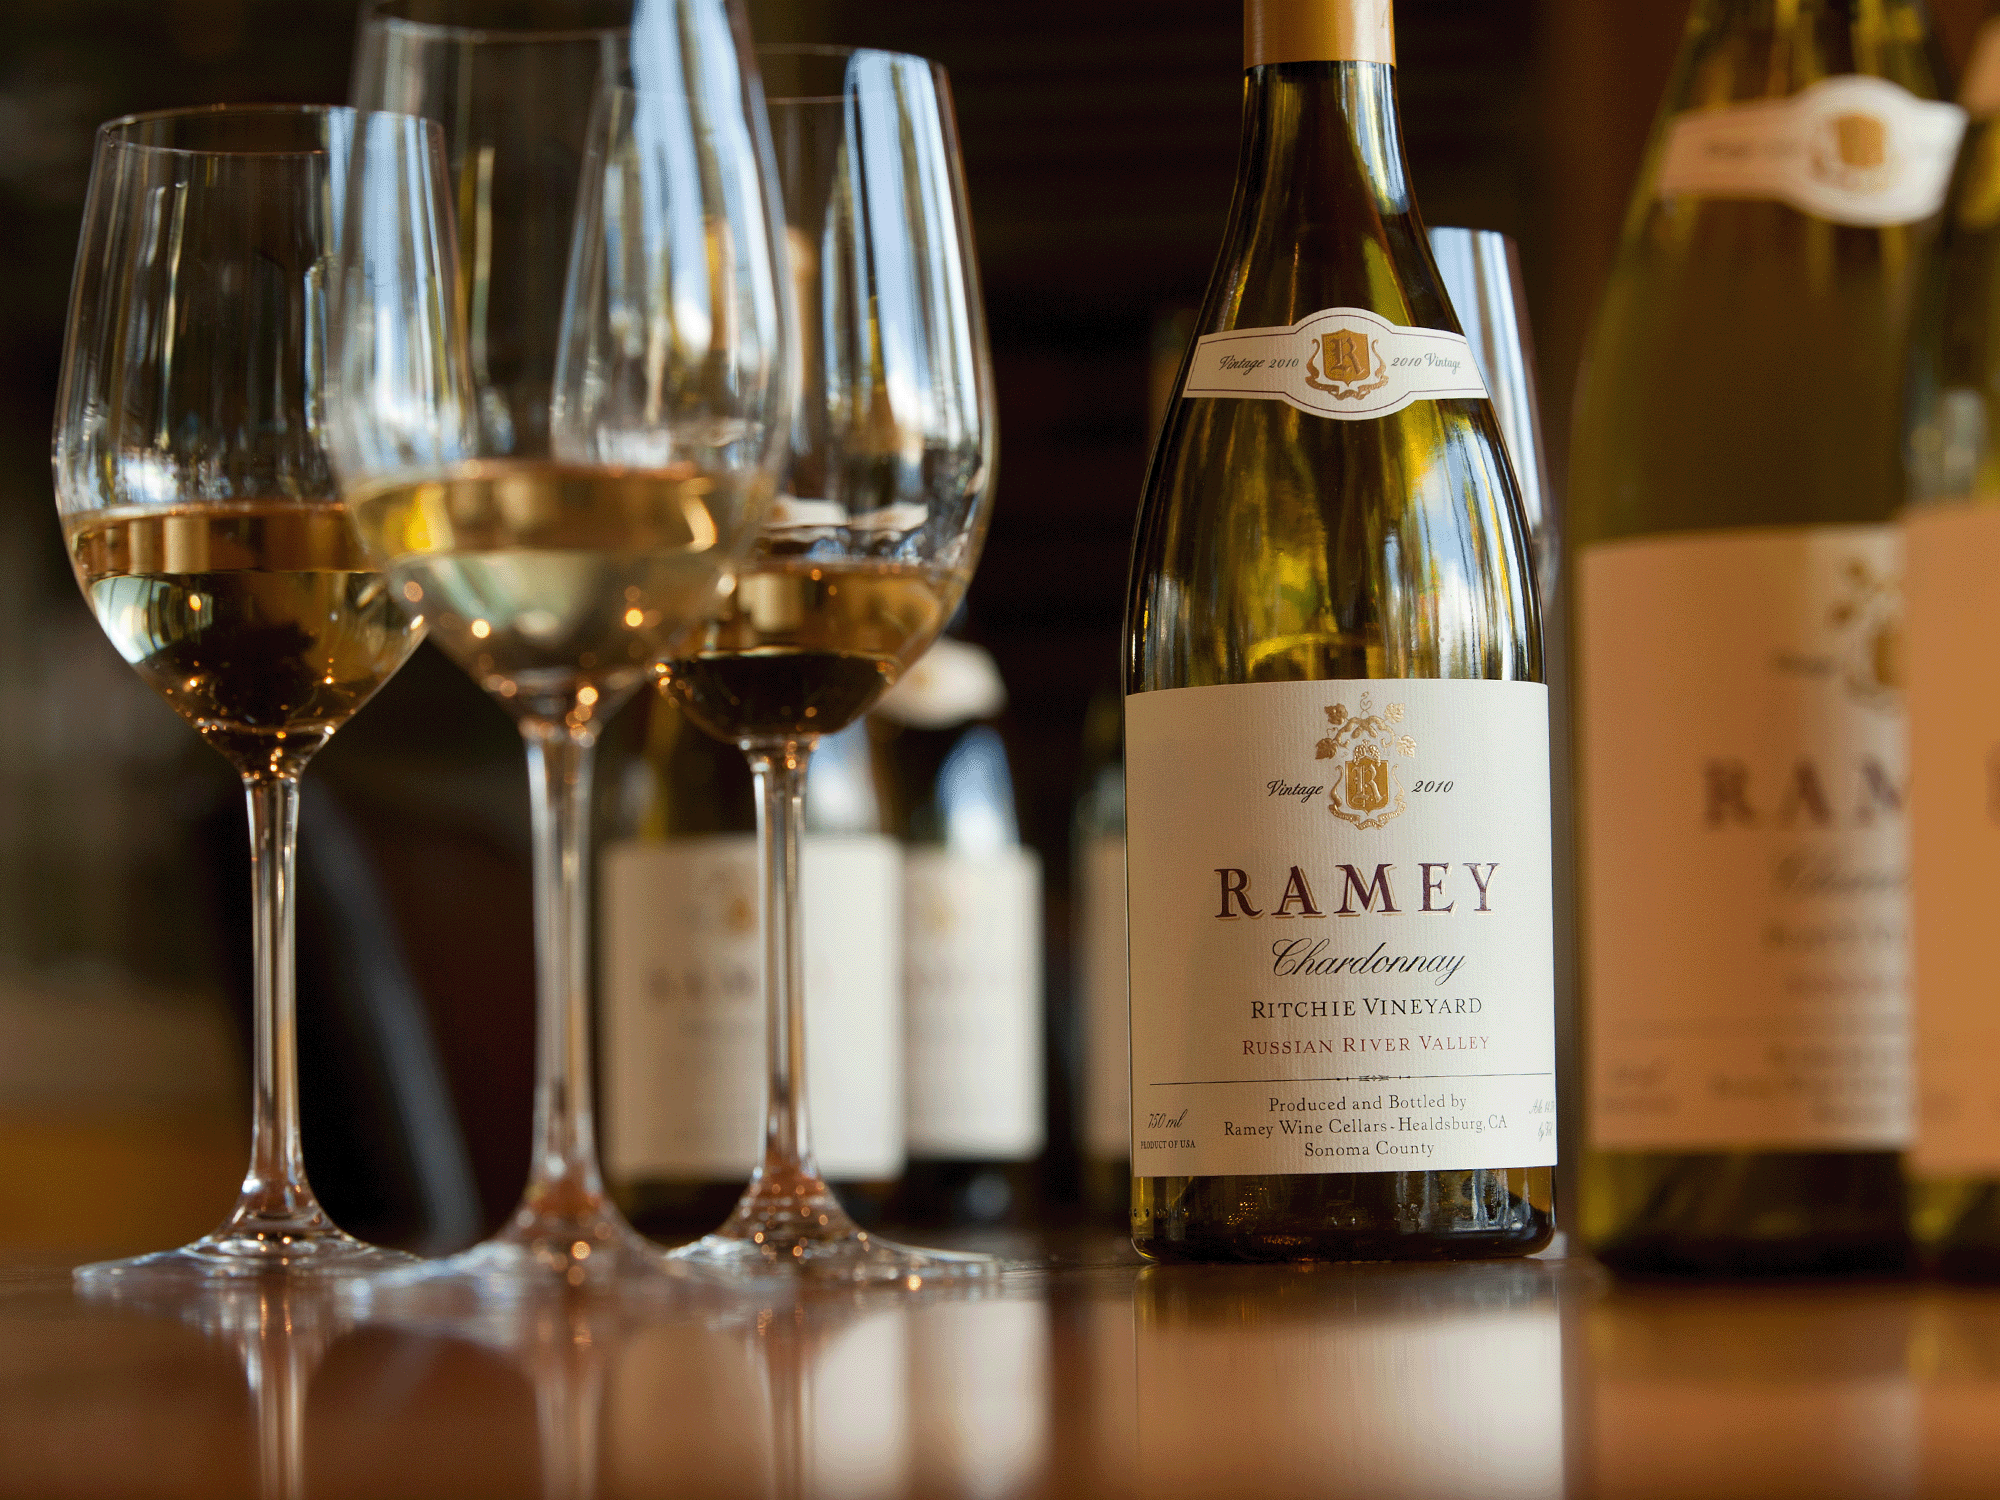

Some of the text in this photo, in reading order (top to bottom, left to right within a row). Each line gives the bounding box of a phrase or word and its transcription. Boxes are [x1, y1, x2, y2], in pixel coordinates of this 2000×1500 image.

[1219, 355, 1300, 375] Vintage 2010
[1390, 352, 1461, 375] 2010 Vintage
[1266, 779, 1325, 803] Vintage
[1411, 779, 1455, 794] 2010
[1214, 861, 1501, 919] RAMEY
[1272, 937, 1466, 986] Chardonnay
[1250, 996, 1483, 1019] RITCHIE VINEYARD
[1242, 1034, 1490, 1056] RUSSIAN RIVER VALLEY
[1268, 1093, 1467, 1113] Produced and Bottled by
[1148, 1112, 1166, 1128] 750
[1224, 1120, 1275, 1139] Ramey
[1279, 1120, 1324, 1135] Wine
[1328, 1117, 1388, 1134] Cellars
[1488, 1113, 1508, 1129] CA
[1140, 1139, 1196, 1149] PRODUCT OF USA
[1304, 1139, 1435, 1158] Sonoma County
